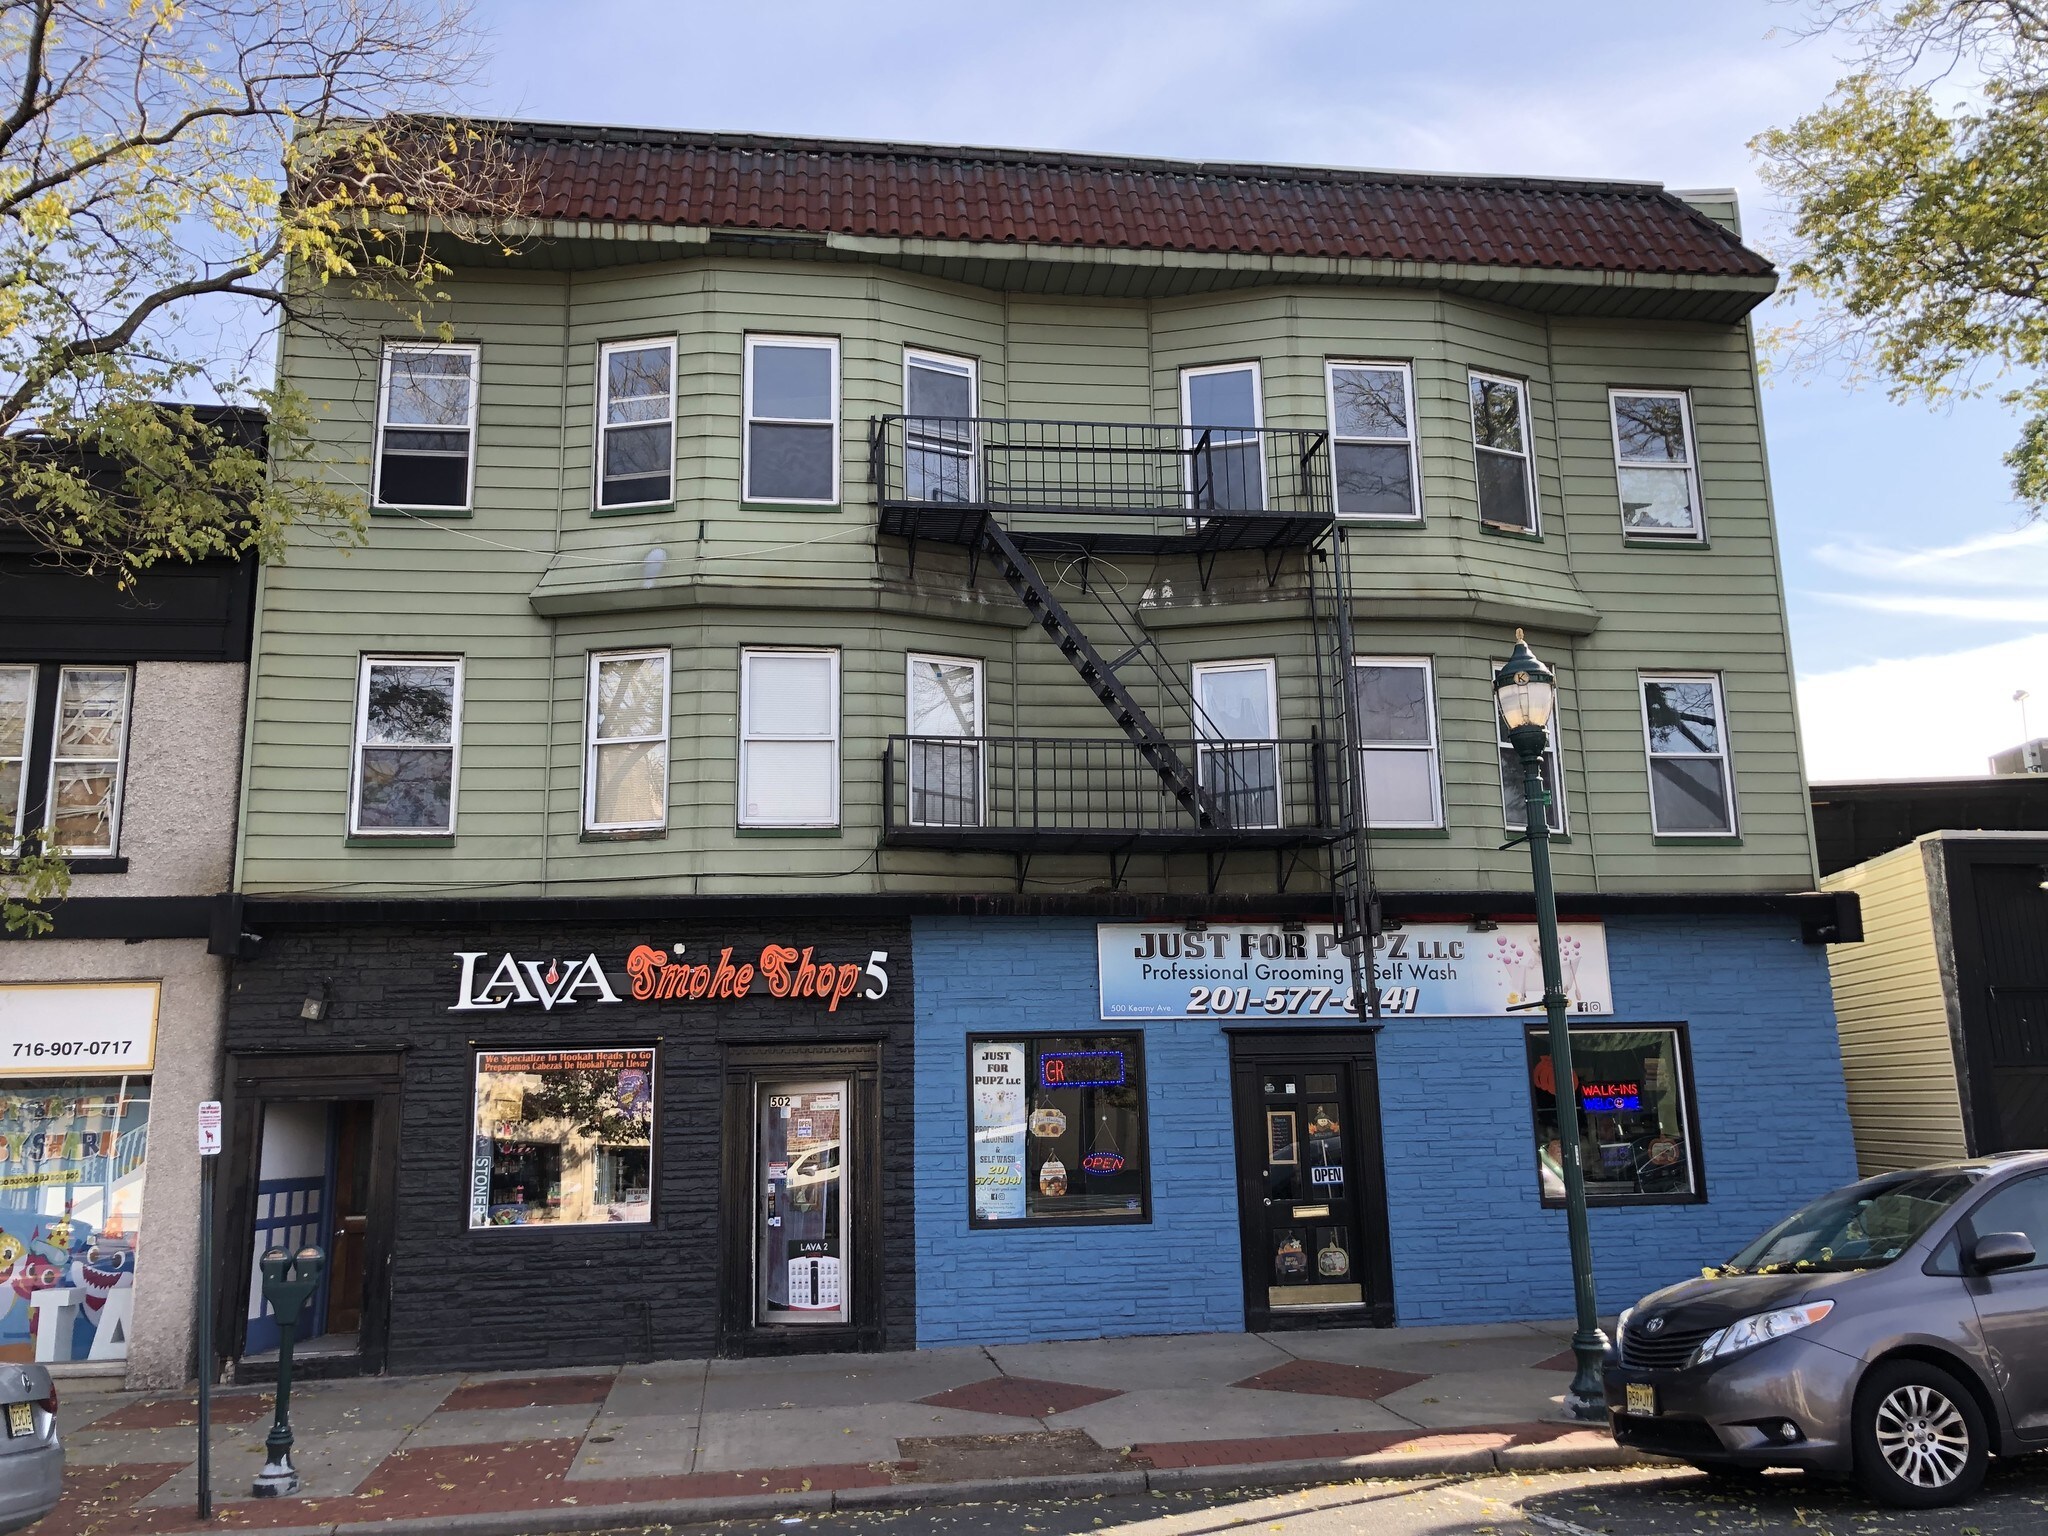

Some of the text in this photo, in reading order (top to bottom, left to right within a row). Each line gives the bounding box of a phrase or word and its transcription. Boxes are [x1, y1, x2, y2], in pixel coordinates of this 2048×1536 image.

[1134, 932, 1230, 960] JUST
[1240, 933, 1308, 960] FOR
[1417, 941, 1465, 960] LLC
[448, 944, 888, 1012] LAVA Smoke Shop 5
[1143, 962, 1249, 981] Professional
[1255, 963, 1344, 984] Grooming
[1373, 963, 1403, 981] Self
[1408, 963, 1457, 980] Wash
[1186, 986, 1419, 1015] 201-577-841
[1110, 1004, 1174, 1014] 500 Kearny Ave.
[12, 1040, 133, 1057] 716-907-0717
[485, 1051, 651, 1064] We Specialize In Hookah Heads To Go
[982, 1052, 1011, 1061] JUST
[484, 1059, 649, 1072] Preparamos Cabezas De Hookah Para Llevar
[987, 1064, 1008, 1072] FOR
[975, 1076, 1004, 1085] PUPZ
[1582, 1084, 1638, 1096] WALK-INS
[771, 1097, 791, 1107] 502
[997, 1155, 1016, 1163] WASH
[1083, 1157, 1125, 1169] OPEN
[988, 1166, 1009, 1174] 201
[1314, 1168, 1341, 1182] OPEN
[474, 1158, 489, 1215] STONER
[800, 1243, 822, 1251] LAVA
